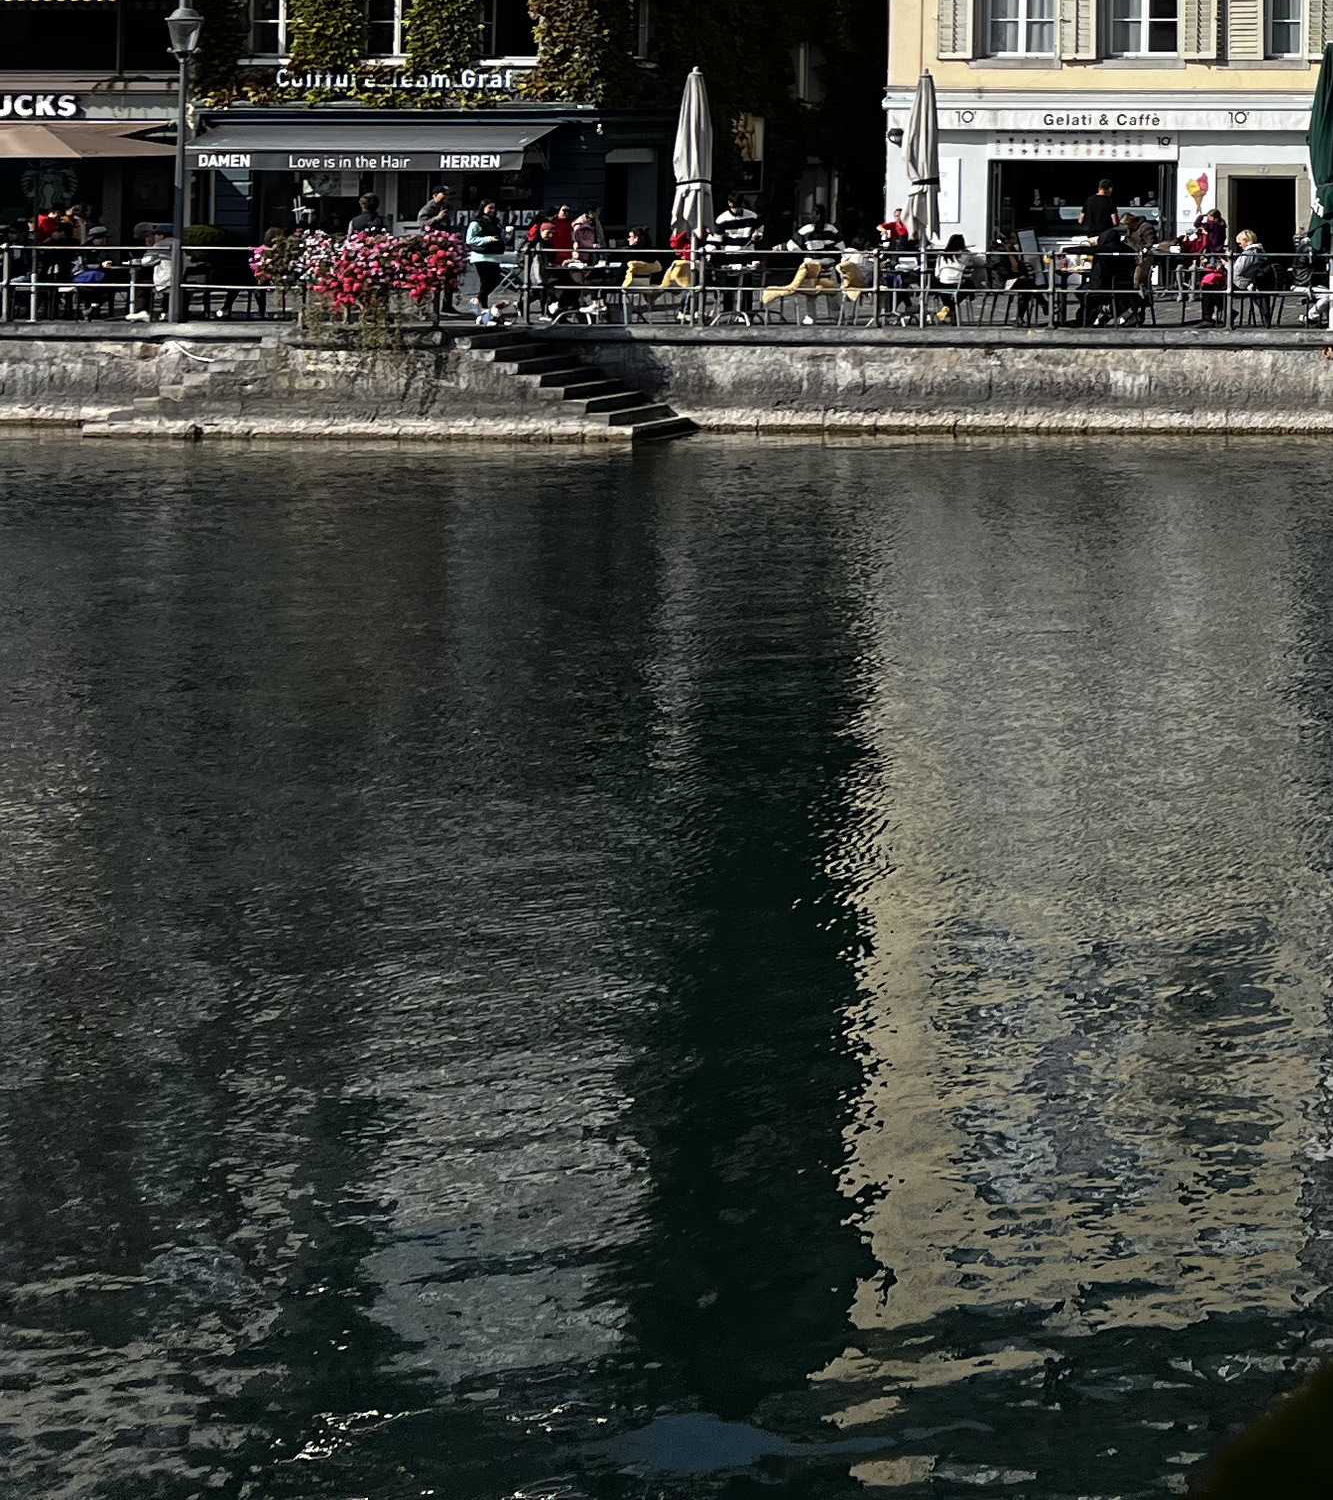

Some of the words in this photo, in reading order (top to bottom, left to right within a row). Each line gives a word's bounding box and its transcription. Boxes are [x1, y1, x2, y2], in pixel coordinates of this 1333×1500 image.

[460, 69, 513, 88] Graf
[1043, 112, 1092, 127] Gelati
[1099, 114, 1109, 126] &
[1116, 112, 1161, 126] Caffè
[198, 154, 250, 168] DAMEN
[289, 155, 320, 168] Love
[324, 155, 335, 168] is
[339, 155, 351, 168] in
[355, 155, 377, 168] the
[381, 155, 410, 168] Hair
[440, 155, 500, 168] HERREN
